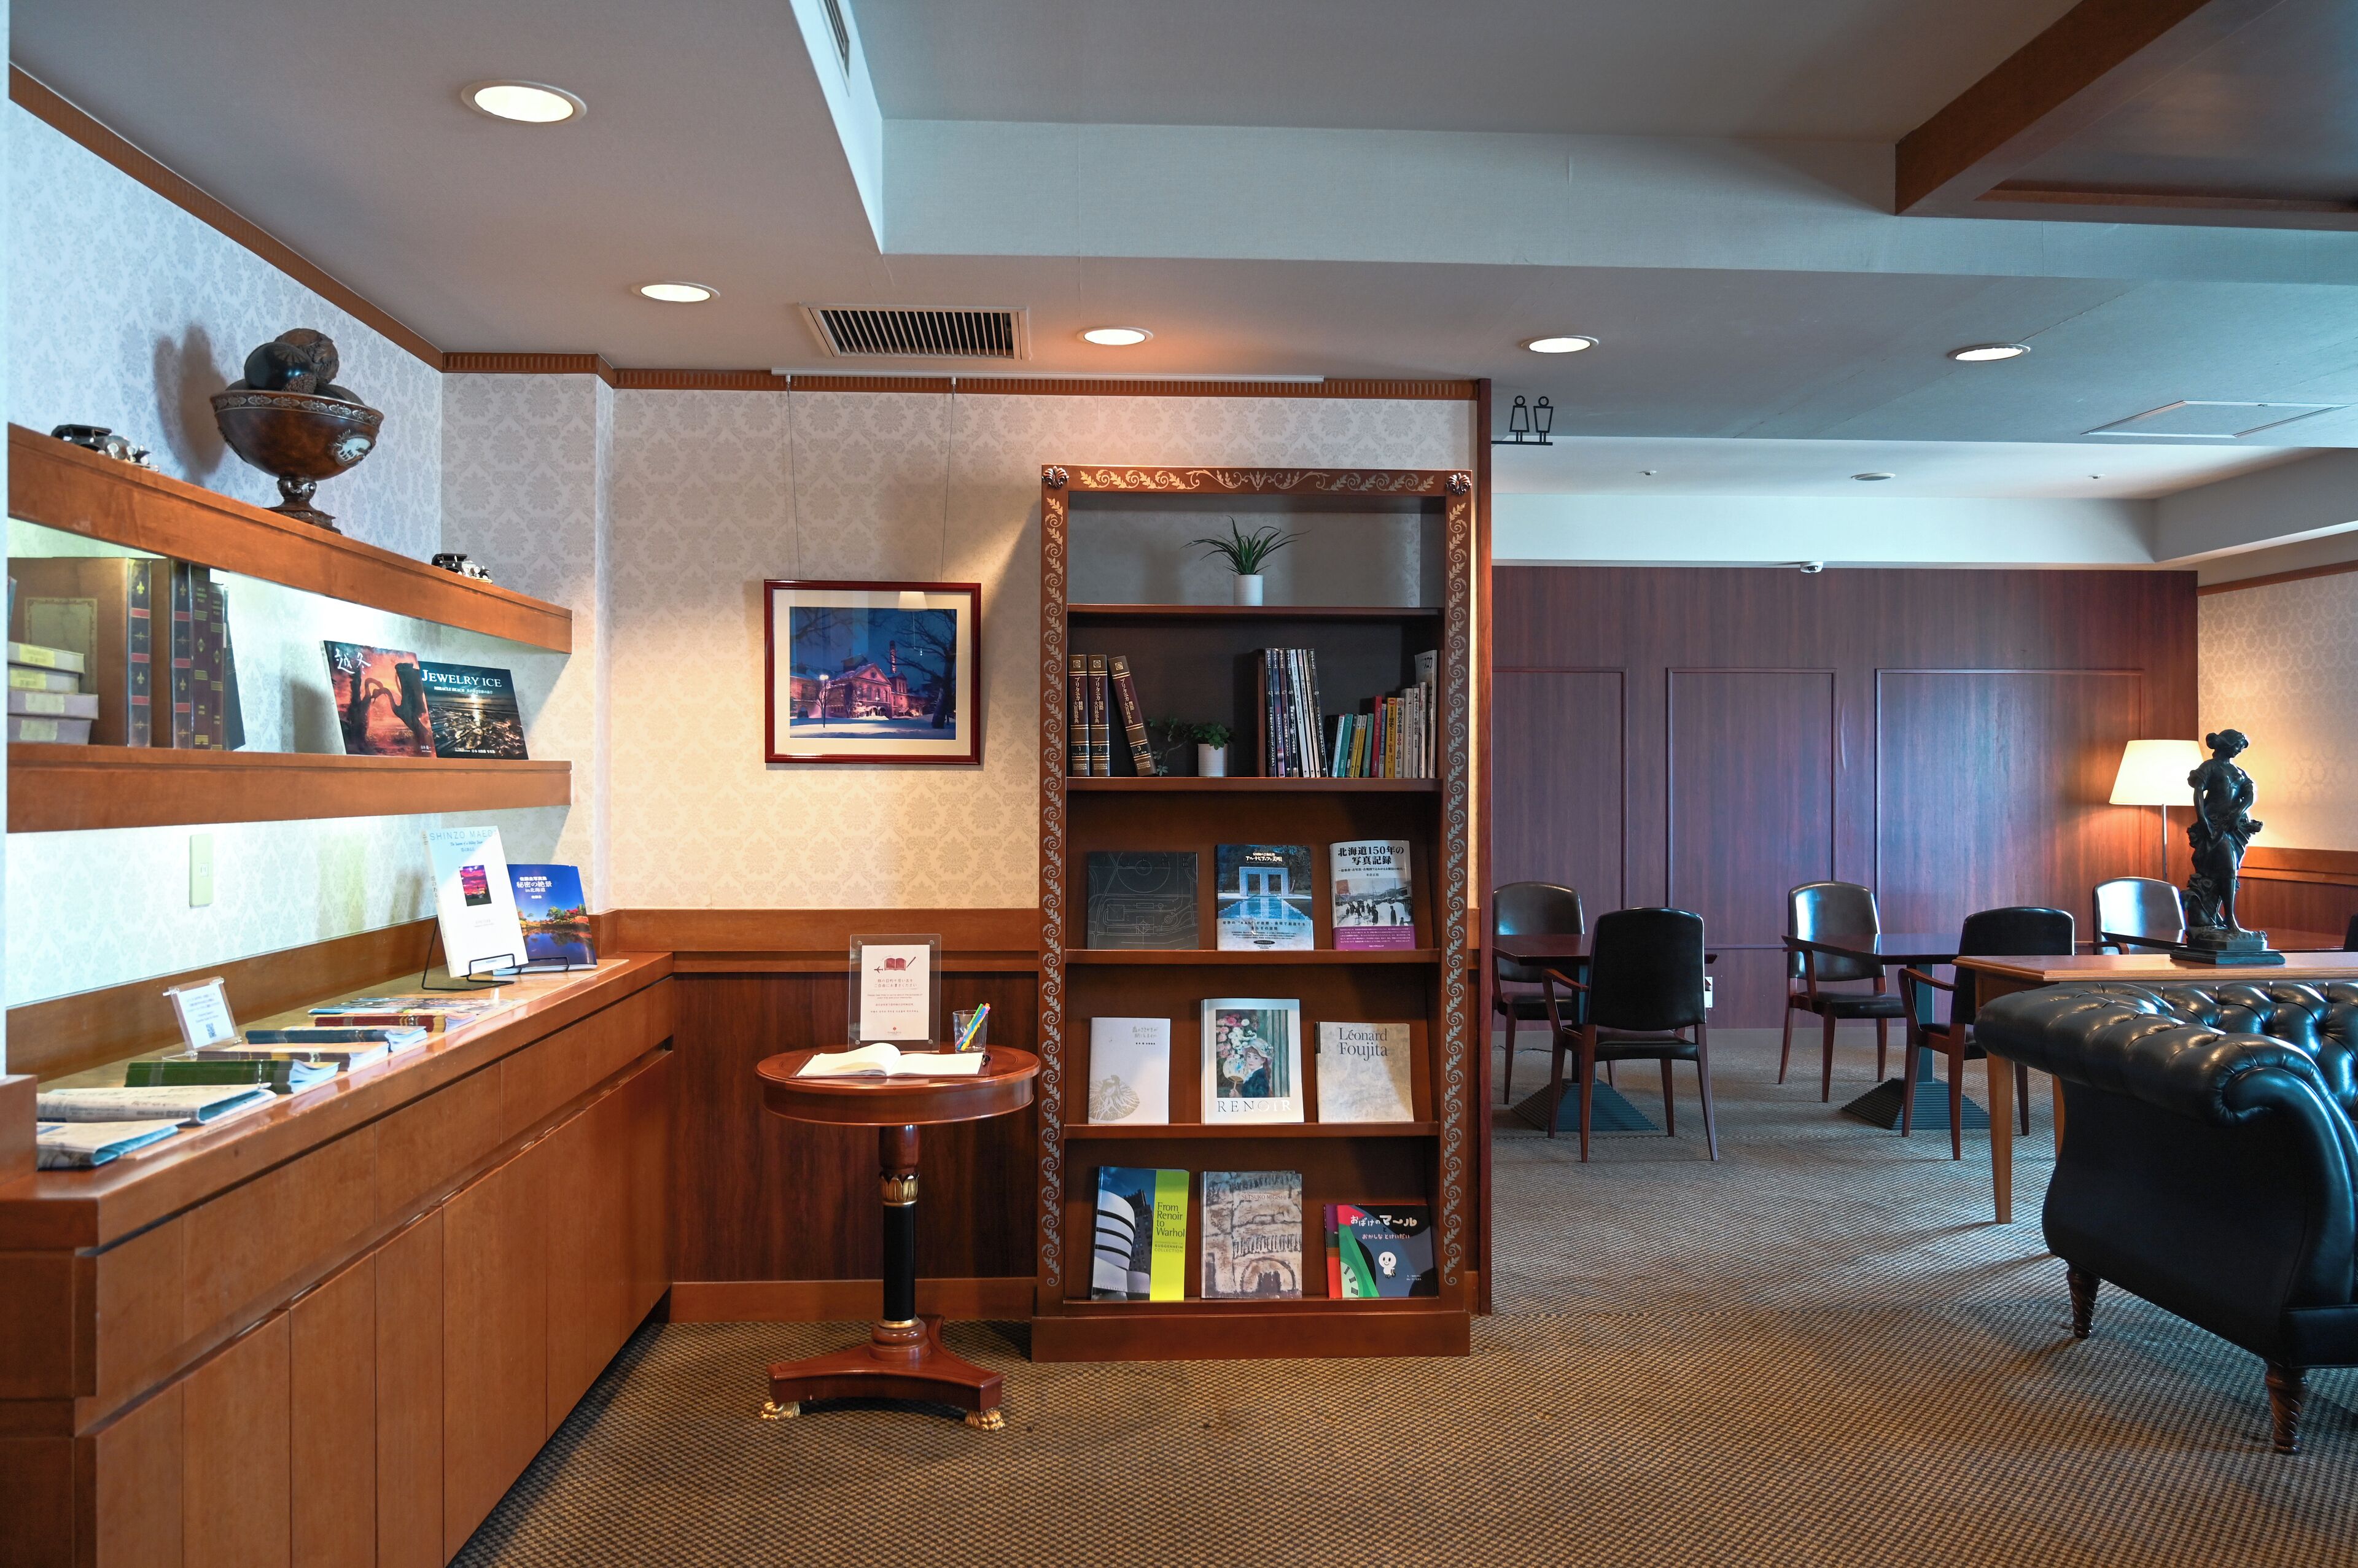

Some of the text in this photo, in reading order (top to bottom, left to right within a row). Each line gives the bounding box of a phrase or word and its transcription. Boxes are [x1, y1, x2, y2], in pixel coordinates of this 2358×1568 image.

[422, 670, 502, 687] JEWELRY ICE
[430, 831, 465, 840] SHINZO
[1338, 846, 1404, 856] 北海道150年の
[1352, 856, 1391, 865] 写真記録
[1339, 1027, 1387, 1041] Léonard
[1339, 1042, 1388, 1061] Foujita
[1218, 1100, 1292, 1112] RENOIR
[1158, 1201, 1178, 1211] From
[1157, 1211, 1183, 1221] Renoir
[1350, 1214, 1417, 1227] おばけのマール
[1156, 1227, 1185, 1237] Warhol
